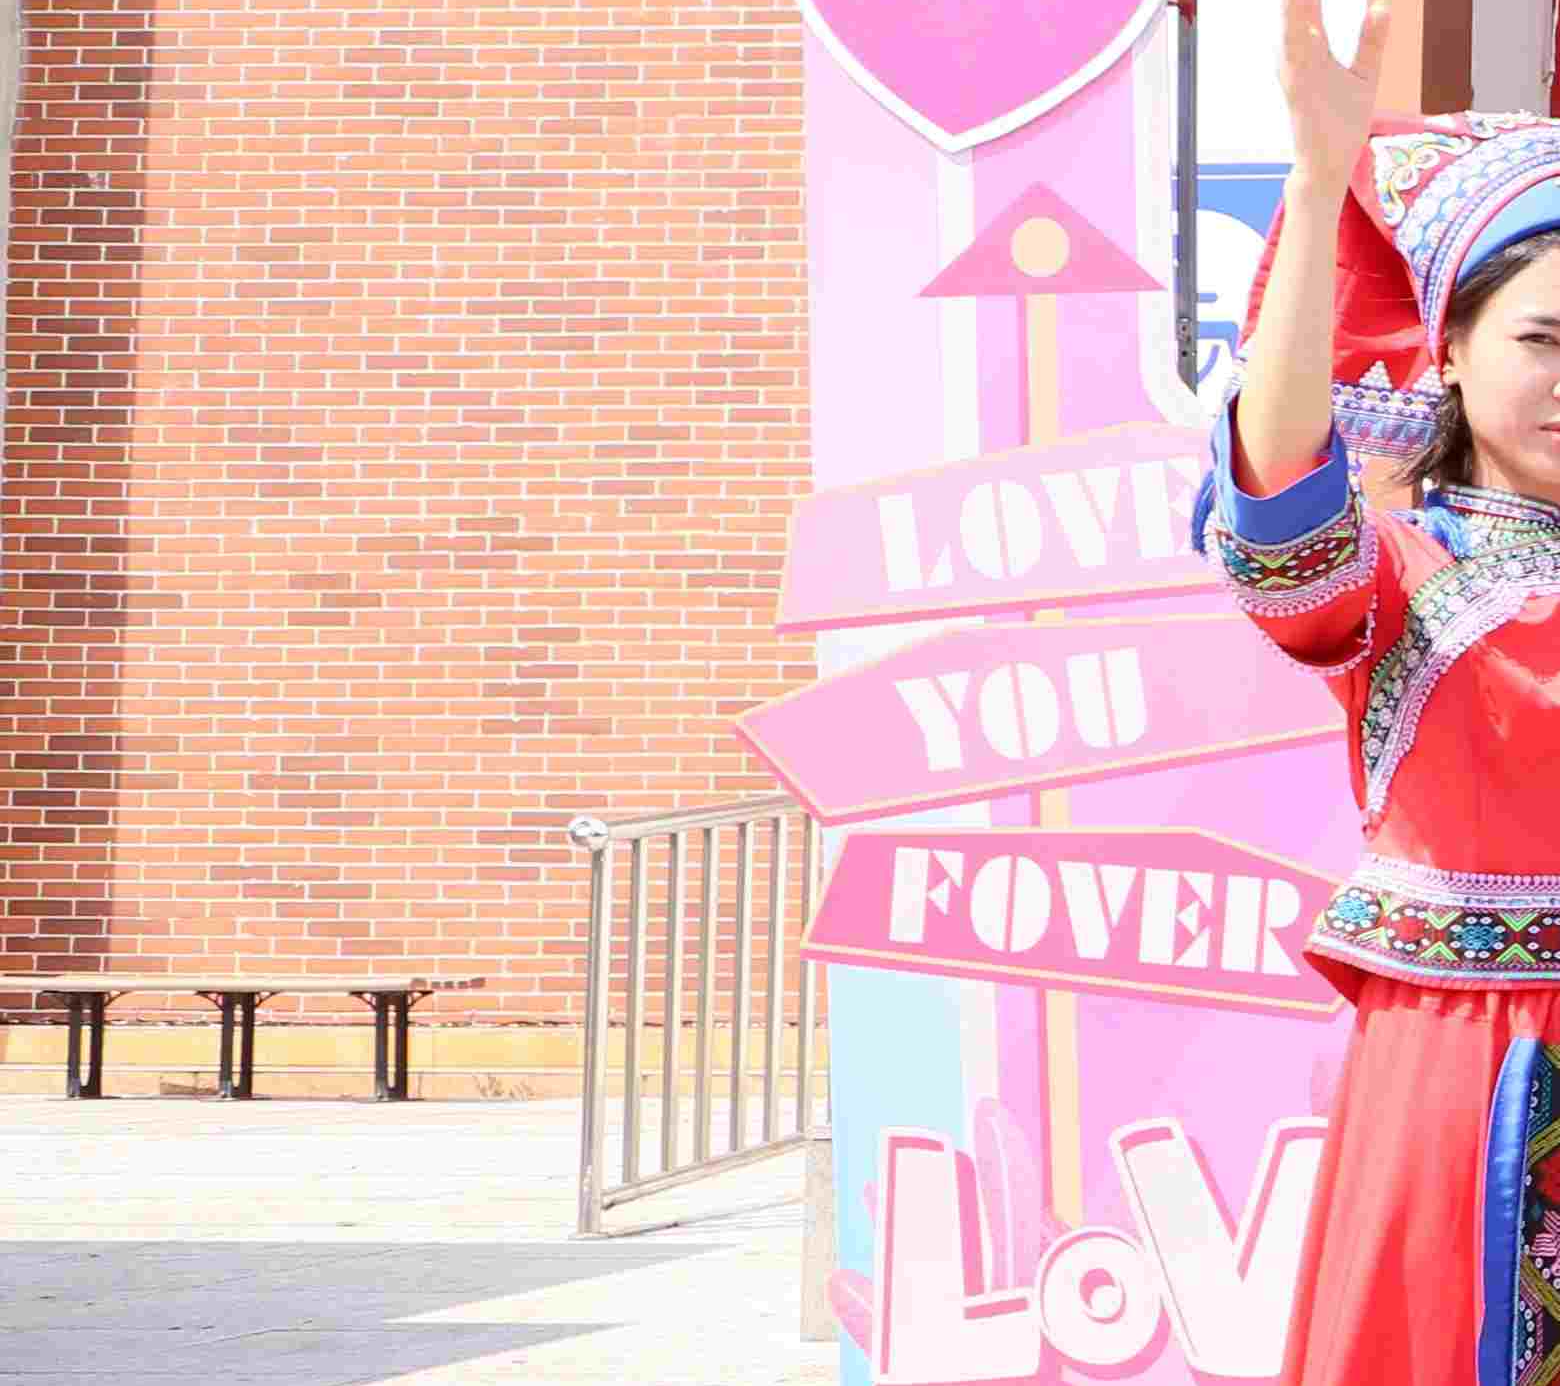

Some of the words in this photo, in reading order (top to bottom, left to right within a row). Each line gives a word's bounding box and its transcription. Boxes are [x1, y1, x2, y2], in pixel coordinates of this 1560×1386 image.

[877, 457, 1200, 593] LOVE
[894, 646, 1150, 773] YOU
[889, 845, 1300, 978] FOVER
